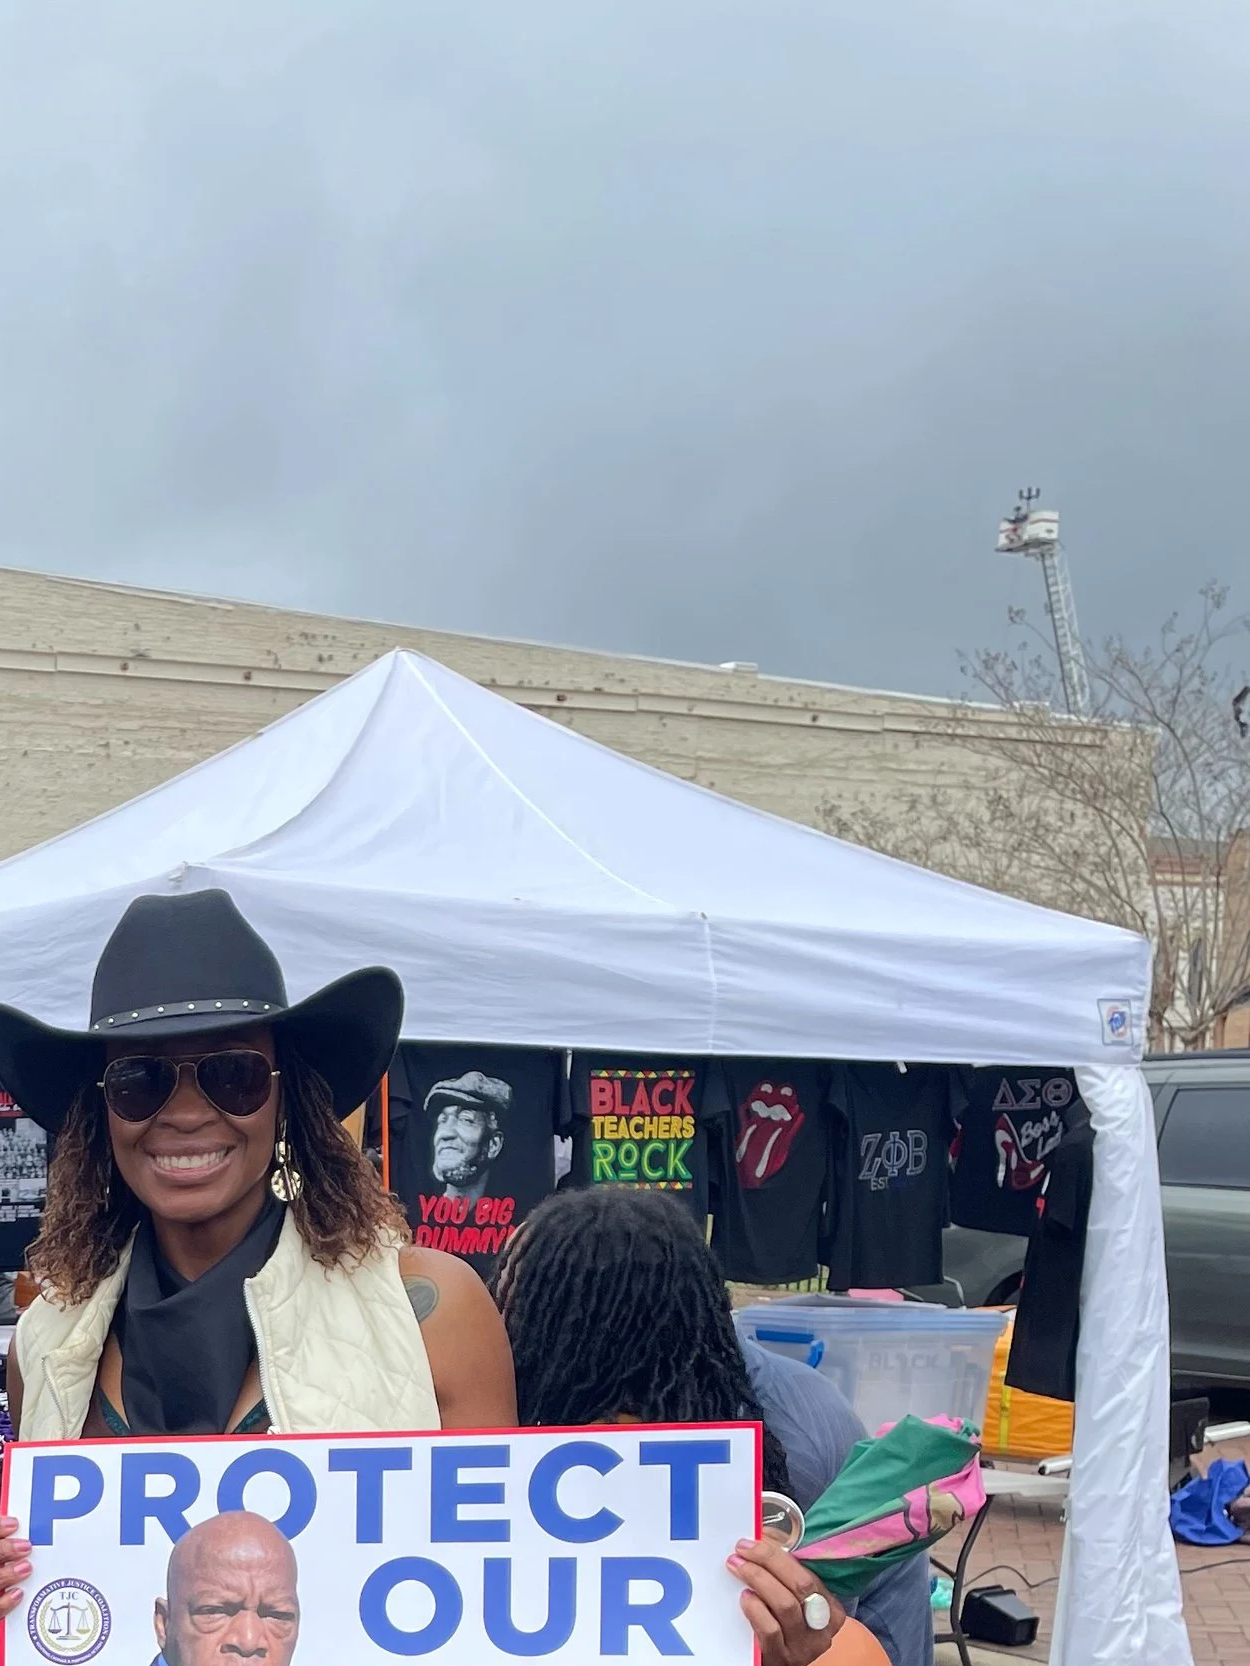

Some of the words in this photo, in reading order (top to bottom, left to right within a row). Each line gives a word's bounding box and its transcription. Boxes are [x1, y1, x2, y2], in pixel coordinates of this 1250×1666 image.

[590, 1078, 696, 1116] BLACK
[591, 1115, 696, 1140] TEACHERS
[418, 1194, 470, 1224] YOU
[475, 1196, 516, 1226] BIG
[28, 1439, 732, 1546] PROTECT
[29, 1580, 66, 1635] TRANSFORMATIVE
[66, 1580, 96, 1595] JUSTICE
[94, 1593, 110, 1635] COALITION
[59, 1591, 79, 1601] TJC
[358, 1556, 694, 1657] OUR
